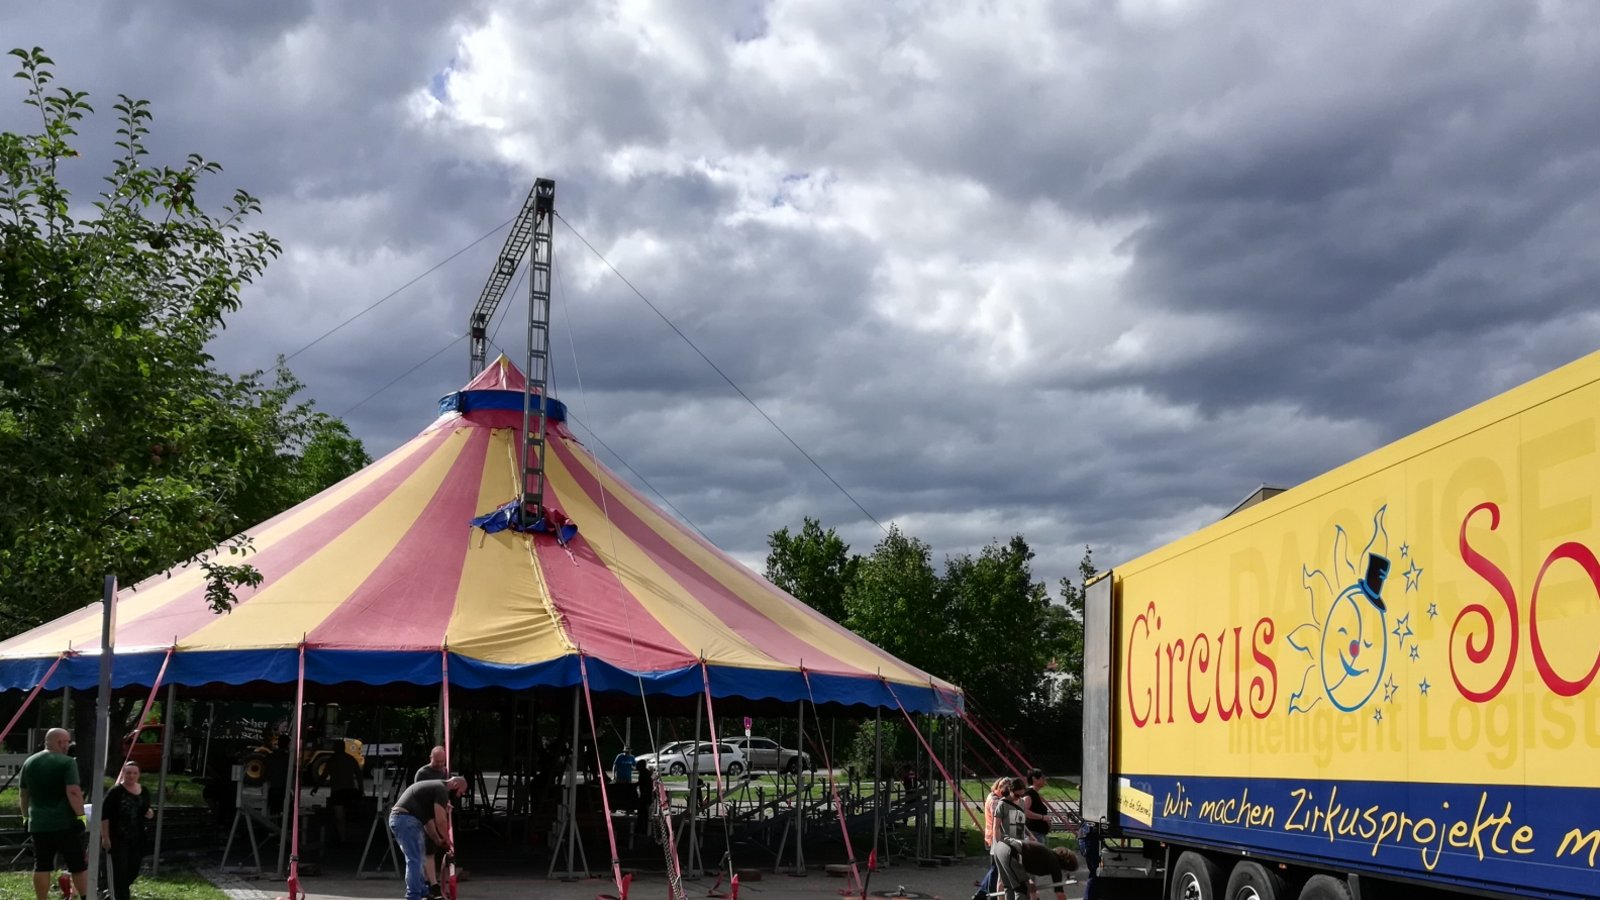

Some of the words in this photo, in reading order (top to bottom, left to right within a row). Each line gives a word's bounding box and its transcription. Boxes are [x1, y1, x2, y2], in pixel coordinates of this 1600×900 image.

[1127, 600, 1278, 728] Circus
[1163, 781, 1193, 819] Wir
[1199, 788, 1274, 829] machen
[1284, 785, 1535, 871] Zirkusprojekte
